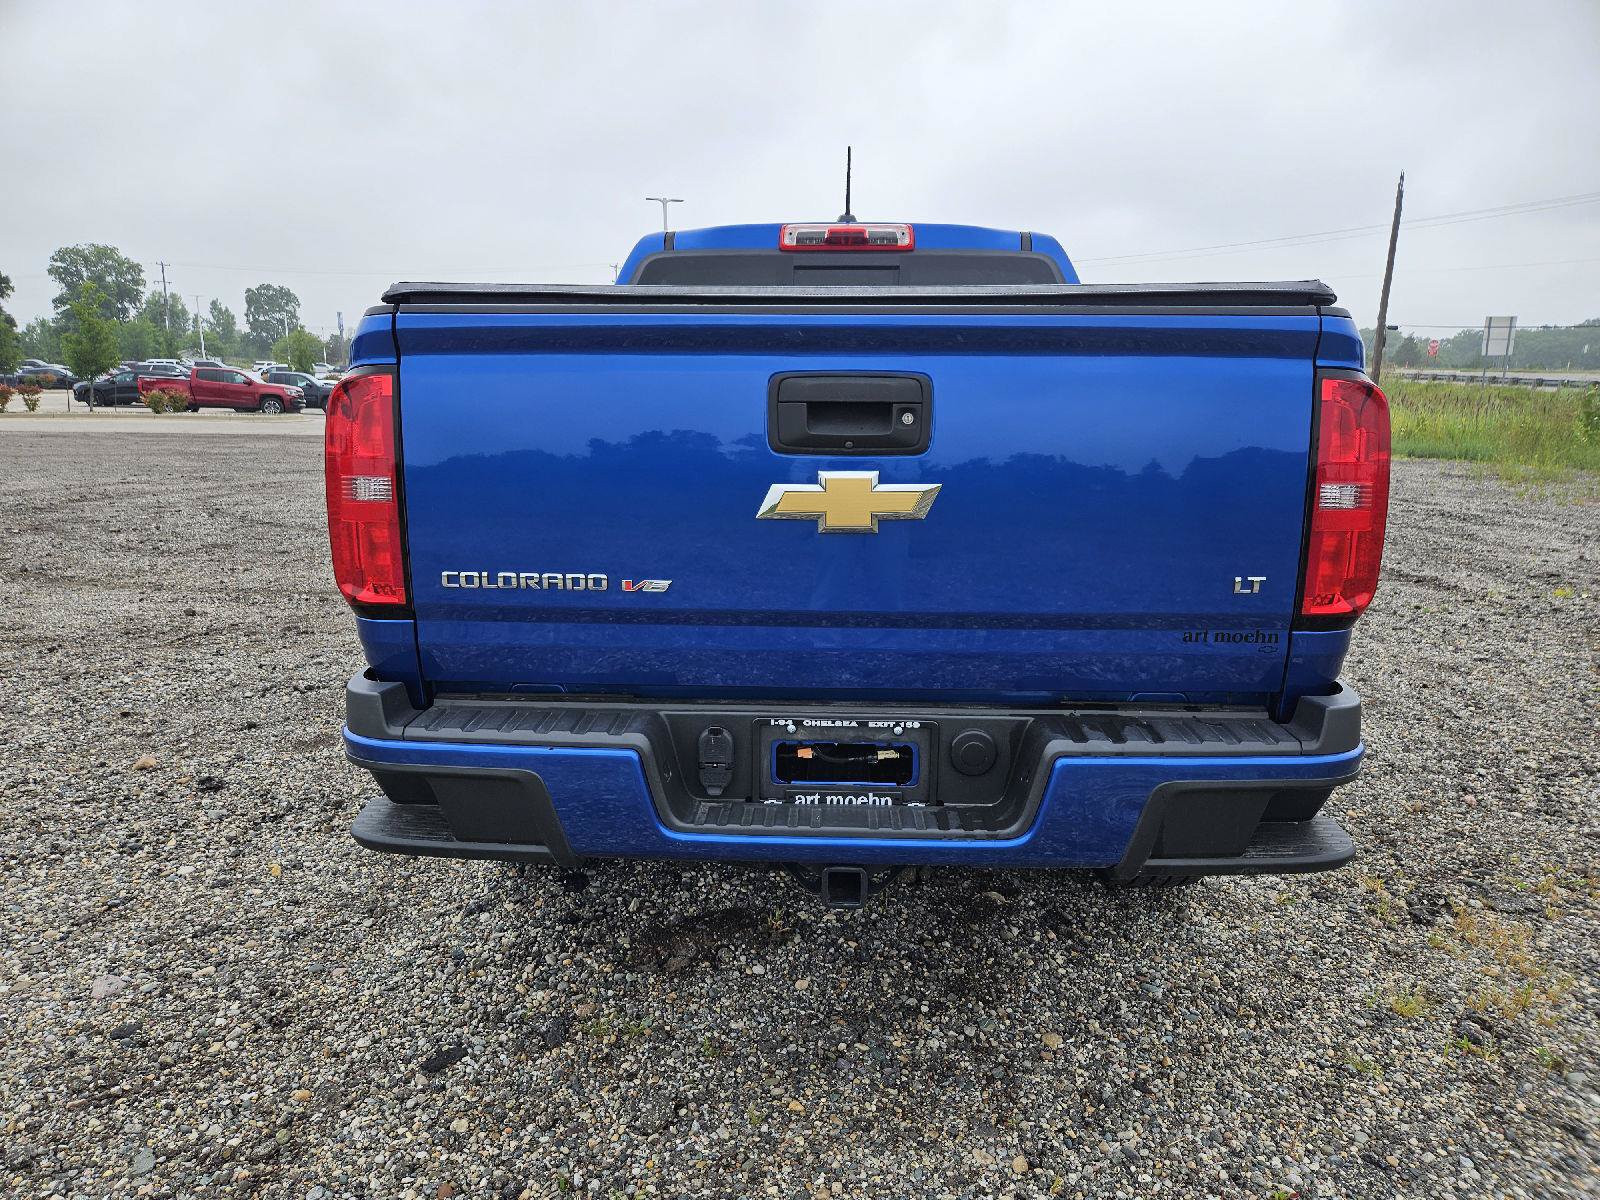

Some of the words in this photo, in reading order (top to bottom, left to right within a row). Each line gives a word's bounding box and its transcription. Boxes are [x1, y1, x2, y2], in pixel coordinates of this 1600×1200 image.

[441, 571, 607, 591] COLORADO
[621, 579, 673, 592] V6
[1234, 576, 1267, 594] LT
[1183, 628, 1208, 643] art
[1214, 629, 1279, 644] moehn
[802, 719, 858, 727] CHELSEA
[795, 793, 821, 805] art
[826, 792, 893, 806] moehn
